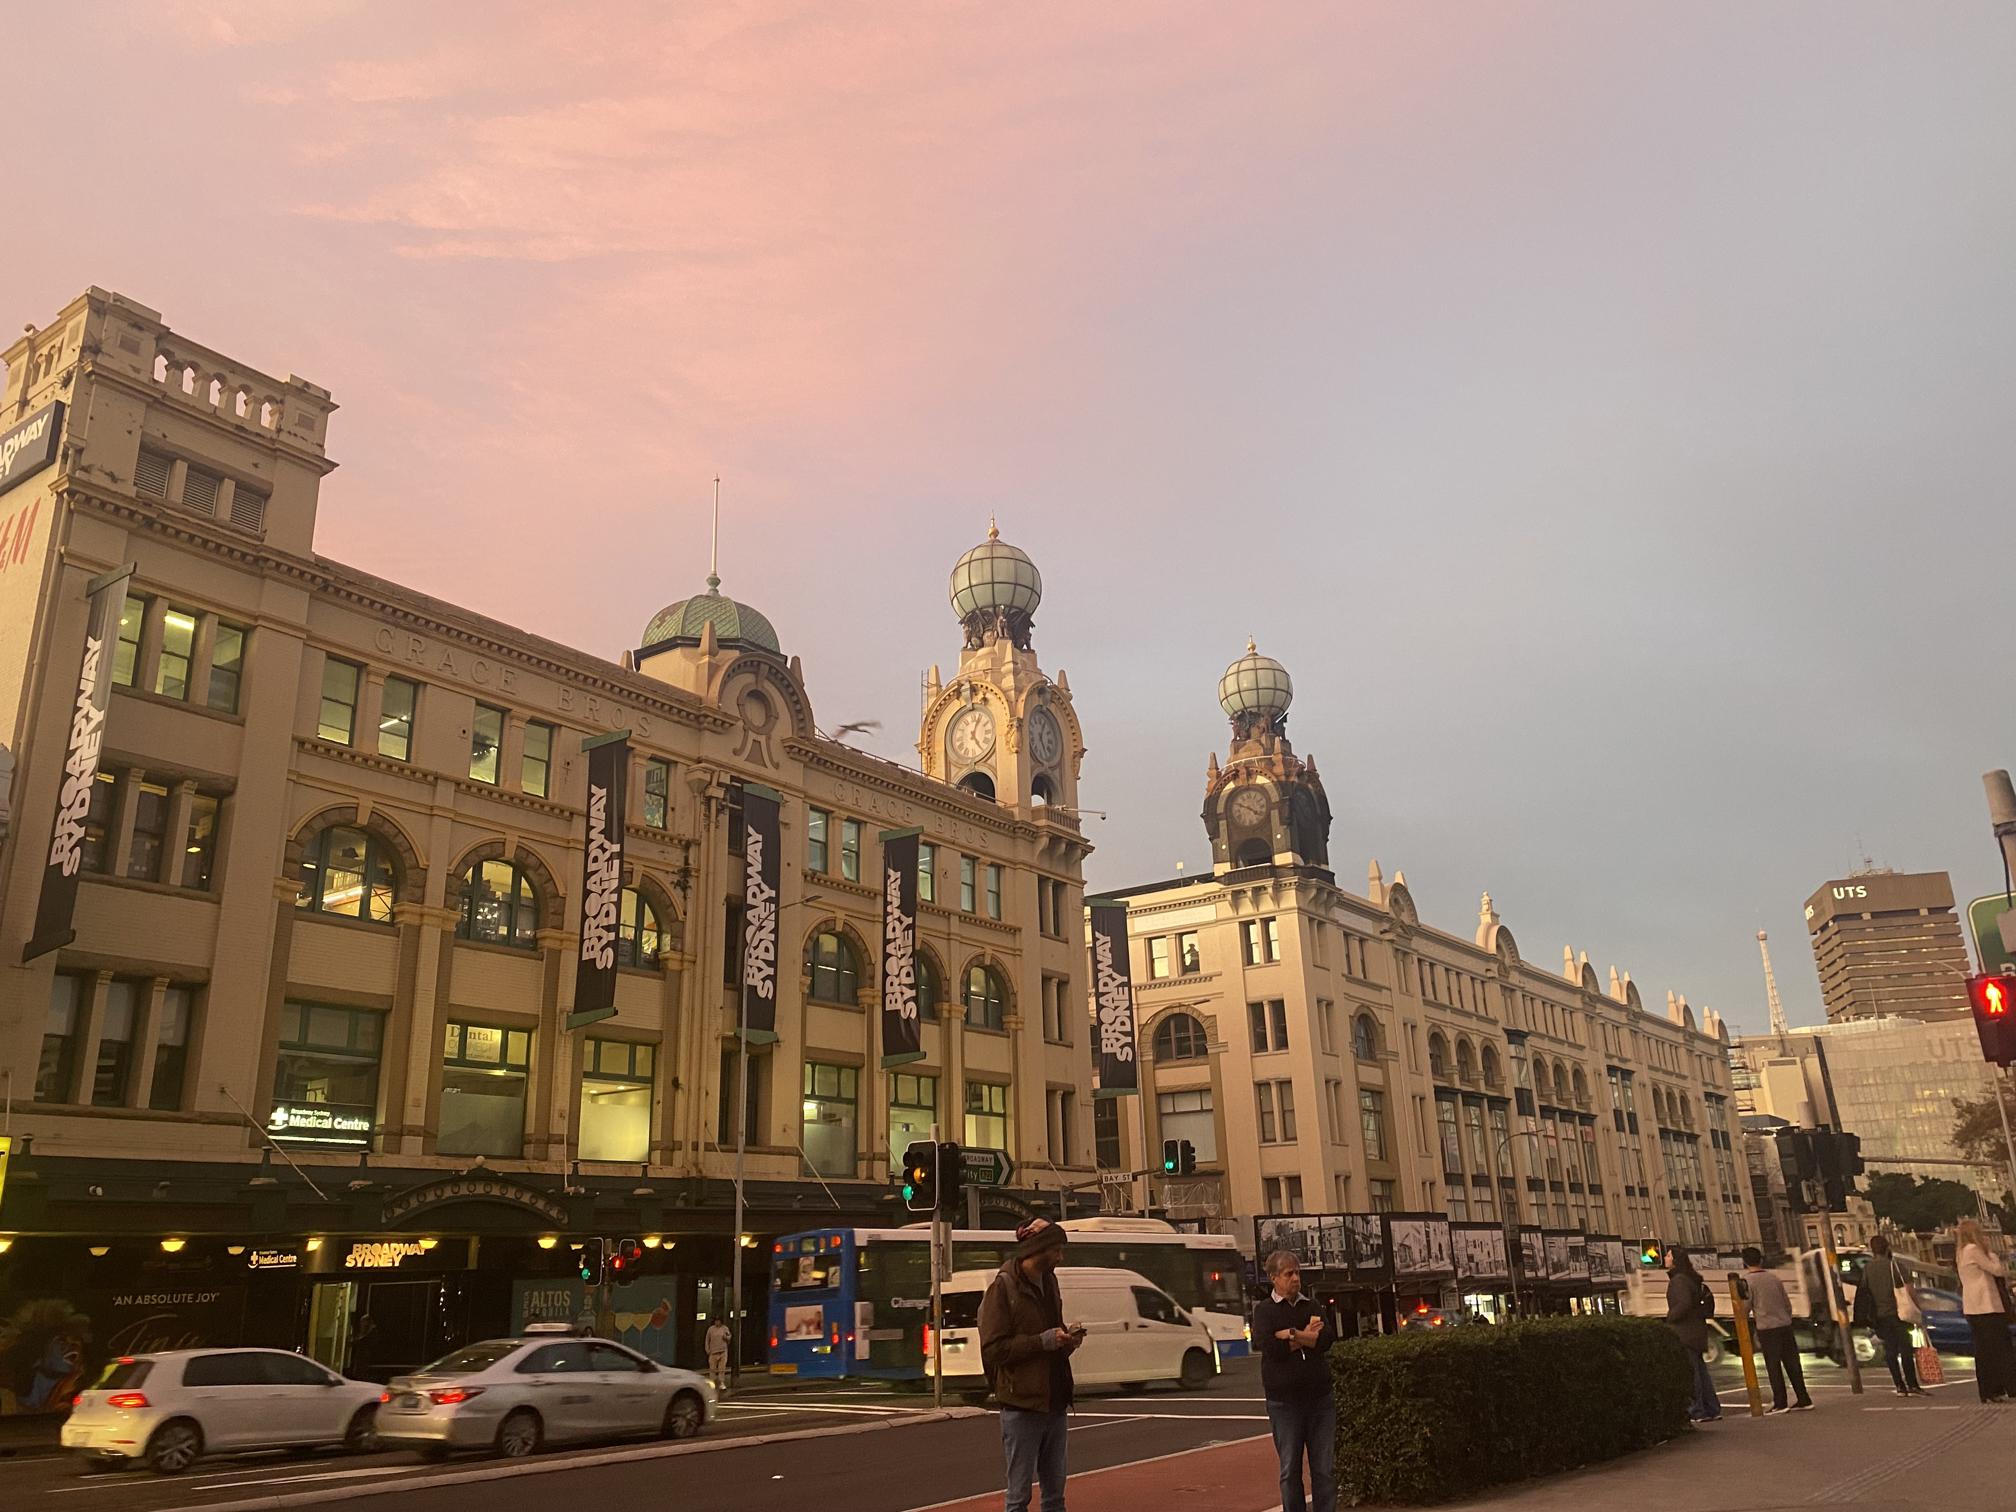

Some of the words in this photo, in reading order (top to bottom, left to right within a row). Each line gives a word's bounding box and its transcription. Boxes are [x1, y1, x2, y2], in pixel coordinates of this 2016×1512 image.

[376, 628, 519, 696] GRACE
[557, 685, 651, 738] BROS
[49, 636, 103, 866] BROADWAY
[62, 709, 105, 877] SYDNEY
[833, 783, 913, 825] GRACE
[934, 814, 990, 849] BROS
[582, 784, 607, 961] BROADWAY
[595, 843, 621, 970] SYDNEY
[744, 824, 764, 986] BROADWAY
[1833, 885, 1867, 899] UTS
[756, 884, 776, 1000] SYDNEY
[885, 867, 901, 1012] BROADWAY
[899, 914, 917, 1020] SYDNEY
[1094, 930, 1117, 1054] BROADWAY
[1113, 973, 1133, 1063] SYDNEY
[288, 1115, 332, 1129] Medical
[333, 1117, 370, 1131] Centre
[134, 1293, 194, 1305] ABSOLUTE
[259, 1254, 279, 1265] Medical
[279, 1253, 297, 1264] Centre
[345, 1253, 403, 1267] SYDNEY
[530, 1290, 572, 1307] ALTOS
